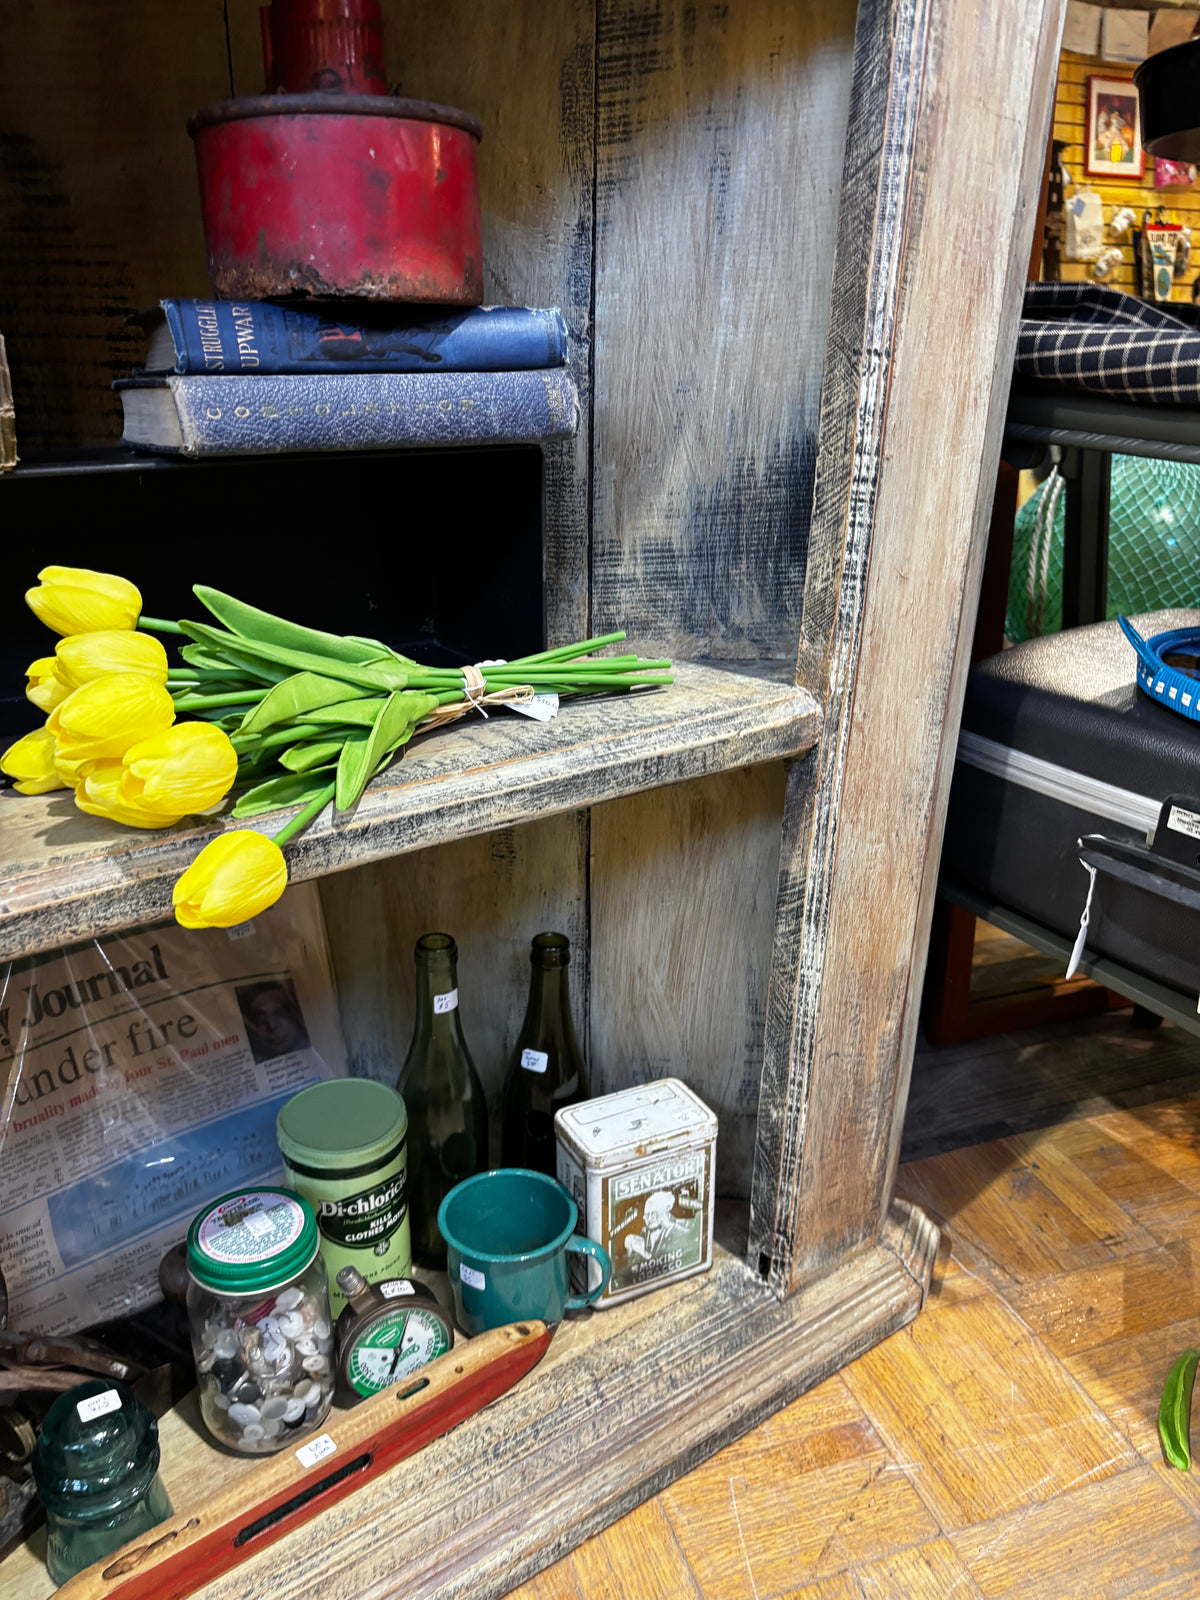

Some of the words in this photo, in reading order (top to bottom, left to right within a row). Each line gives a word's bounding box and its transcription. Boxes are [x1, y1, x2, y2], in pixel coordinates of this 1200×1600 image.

[231, 302, 260, 368] UPWAR
[21, 944, 170, 1028] Journal
[127, 1013, 198, 1058] fire
[124, 1065, 152, 1086] four
[157, 1056, 176, 1072] St.
[181, 1043, 209, 1062] Paul
[213, 1032, 240, 1051] men
[618, 1160, 697, 1196] SENATOR
[345, 1225, 385, 1243] CLOTHES
[370, 1211, 393, 1229] KILLS
